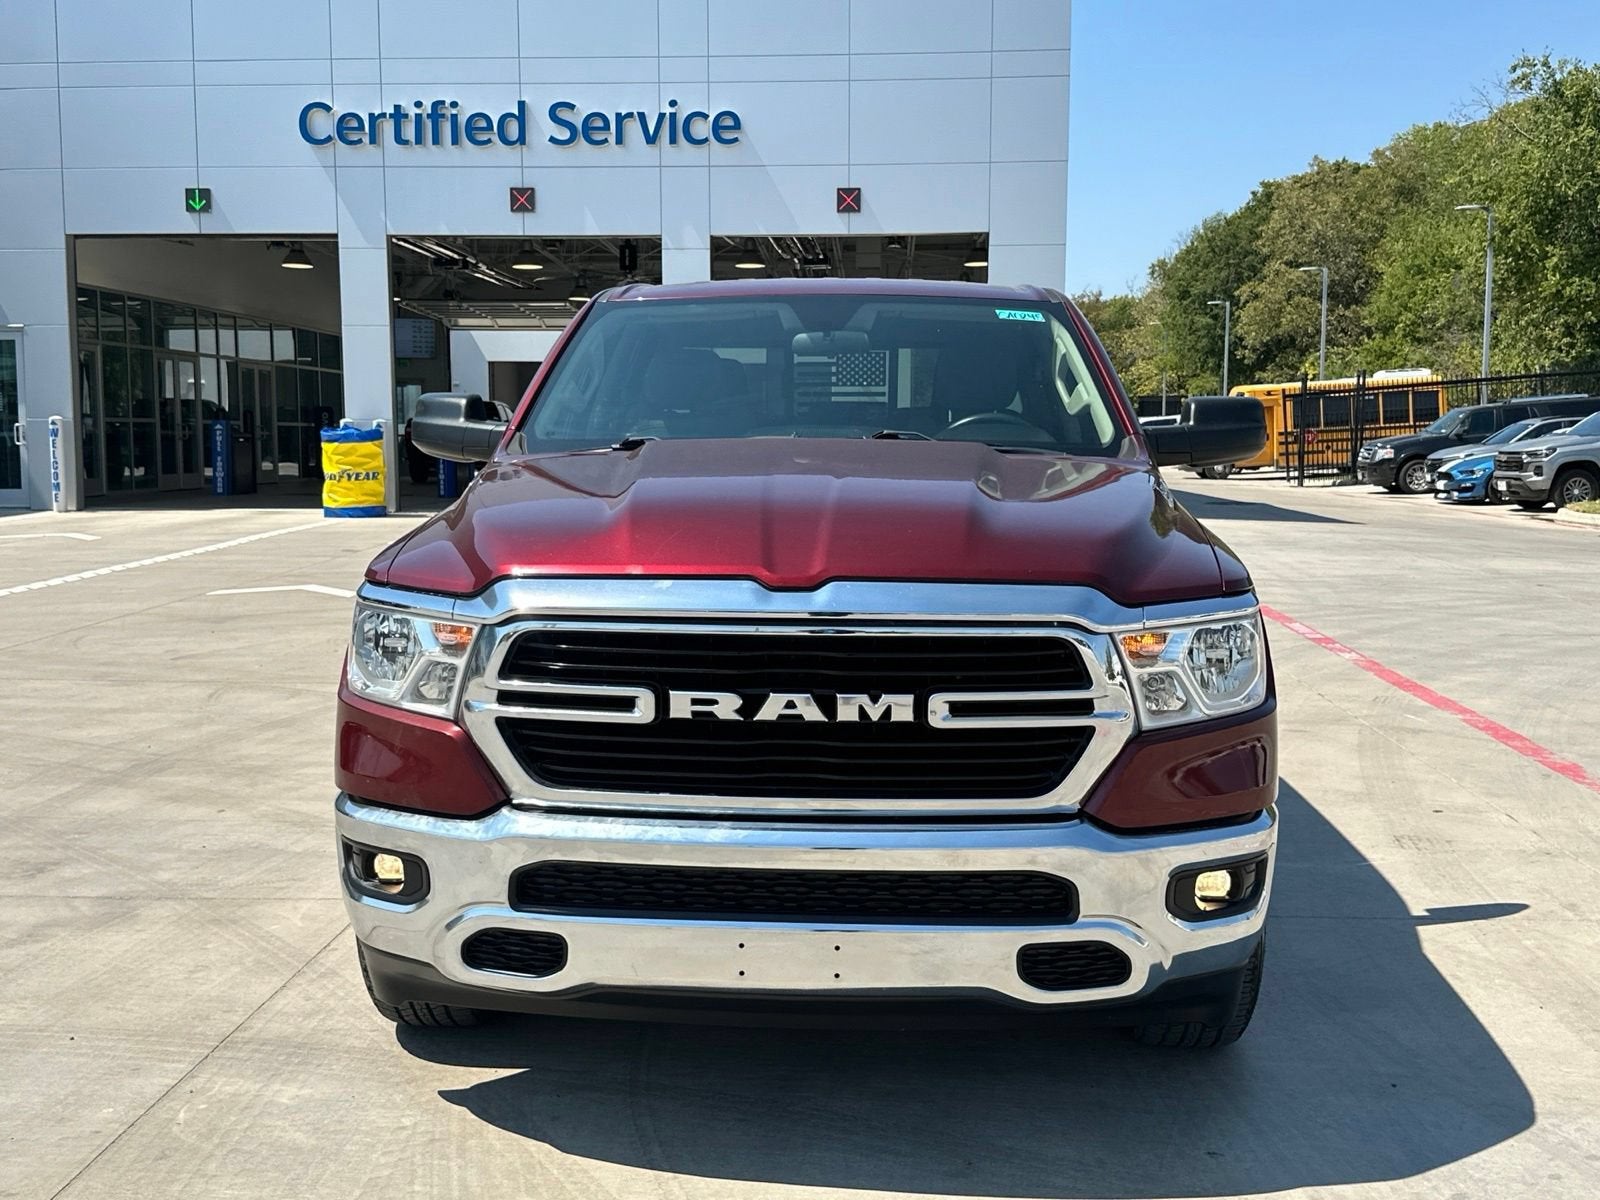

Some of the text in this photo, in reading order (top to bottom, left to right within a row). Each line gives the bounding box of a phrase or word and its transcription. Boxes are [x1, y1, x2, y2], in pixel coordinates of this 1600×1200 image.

[299, 99, 742, 147] Certified Service
[48, 427, 61, 503] WELCOME
[669, 690, 914, 722] RAM
